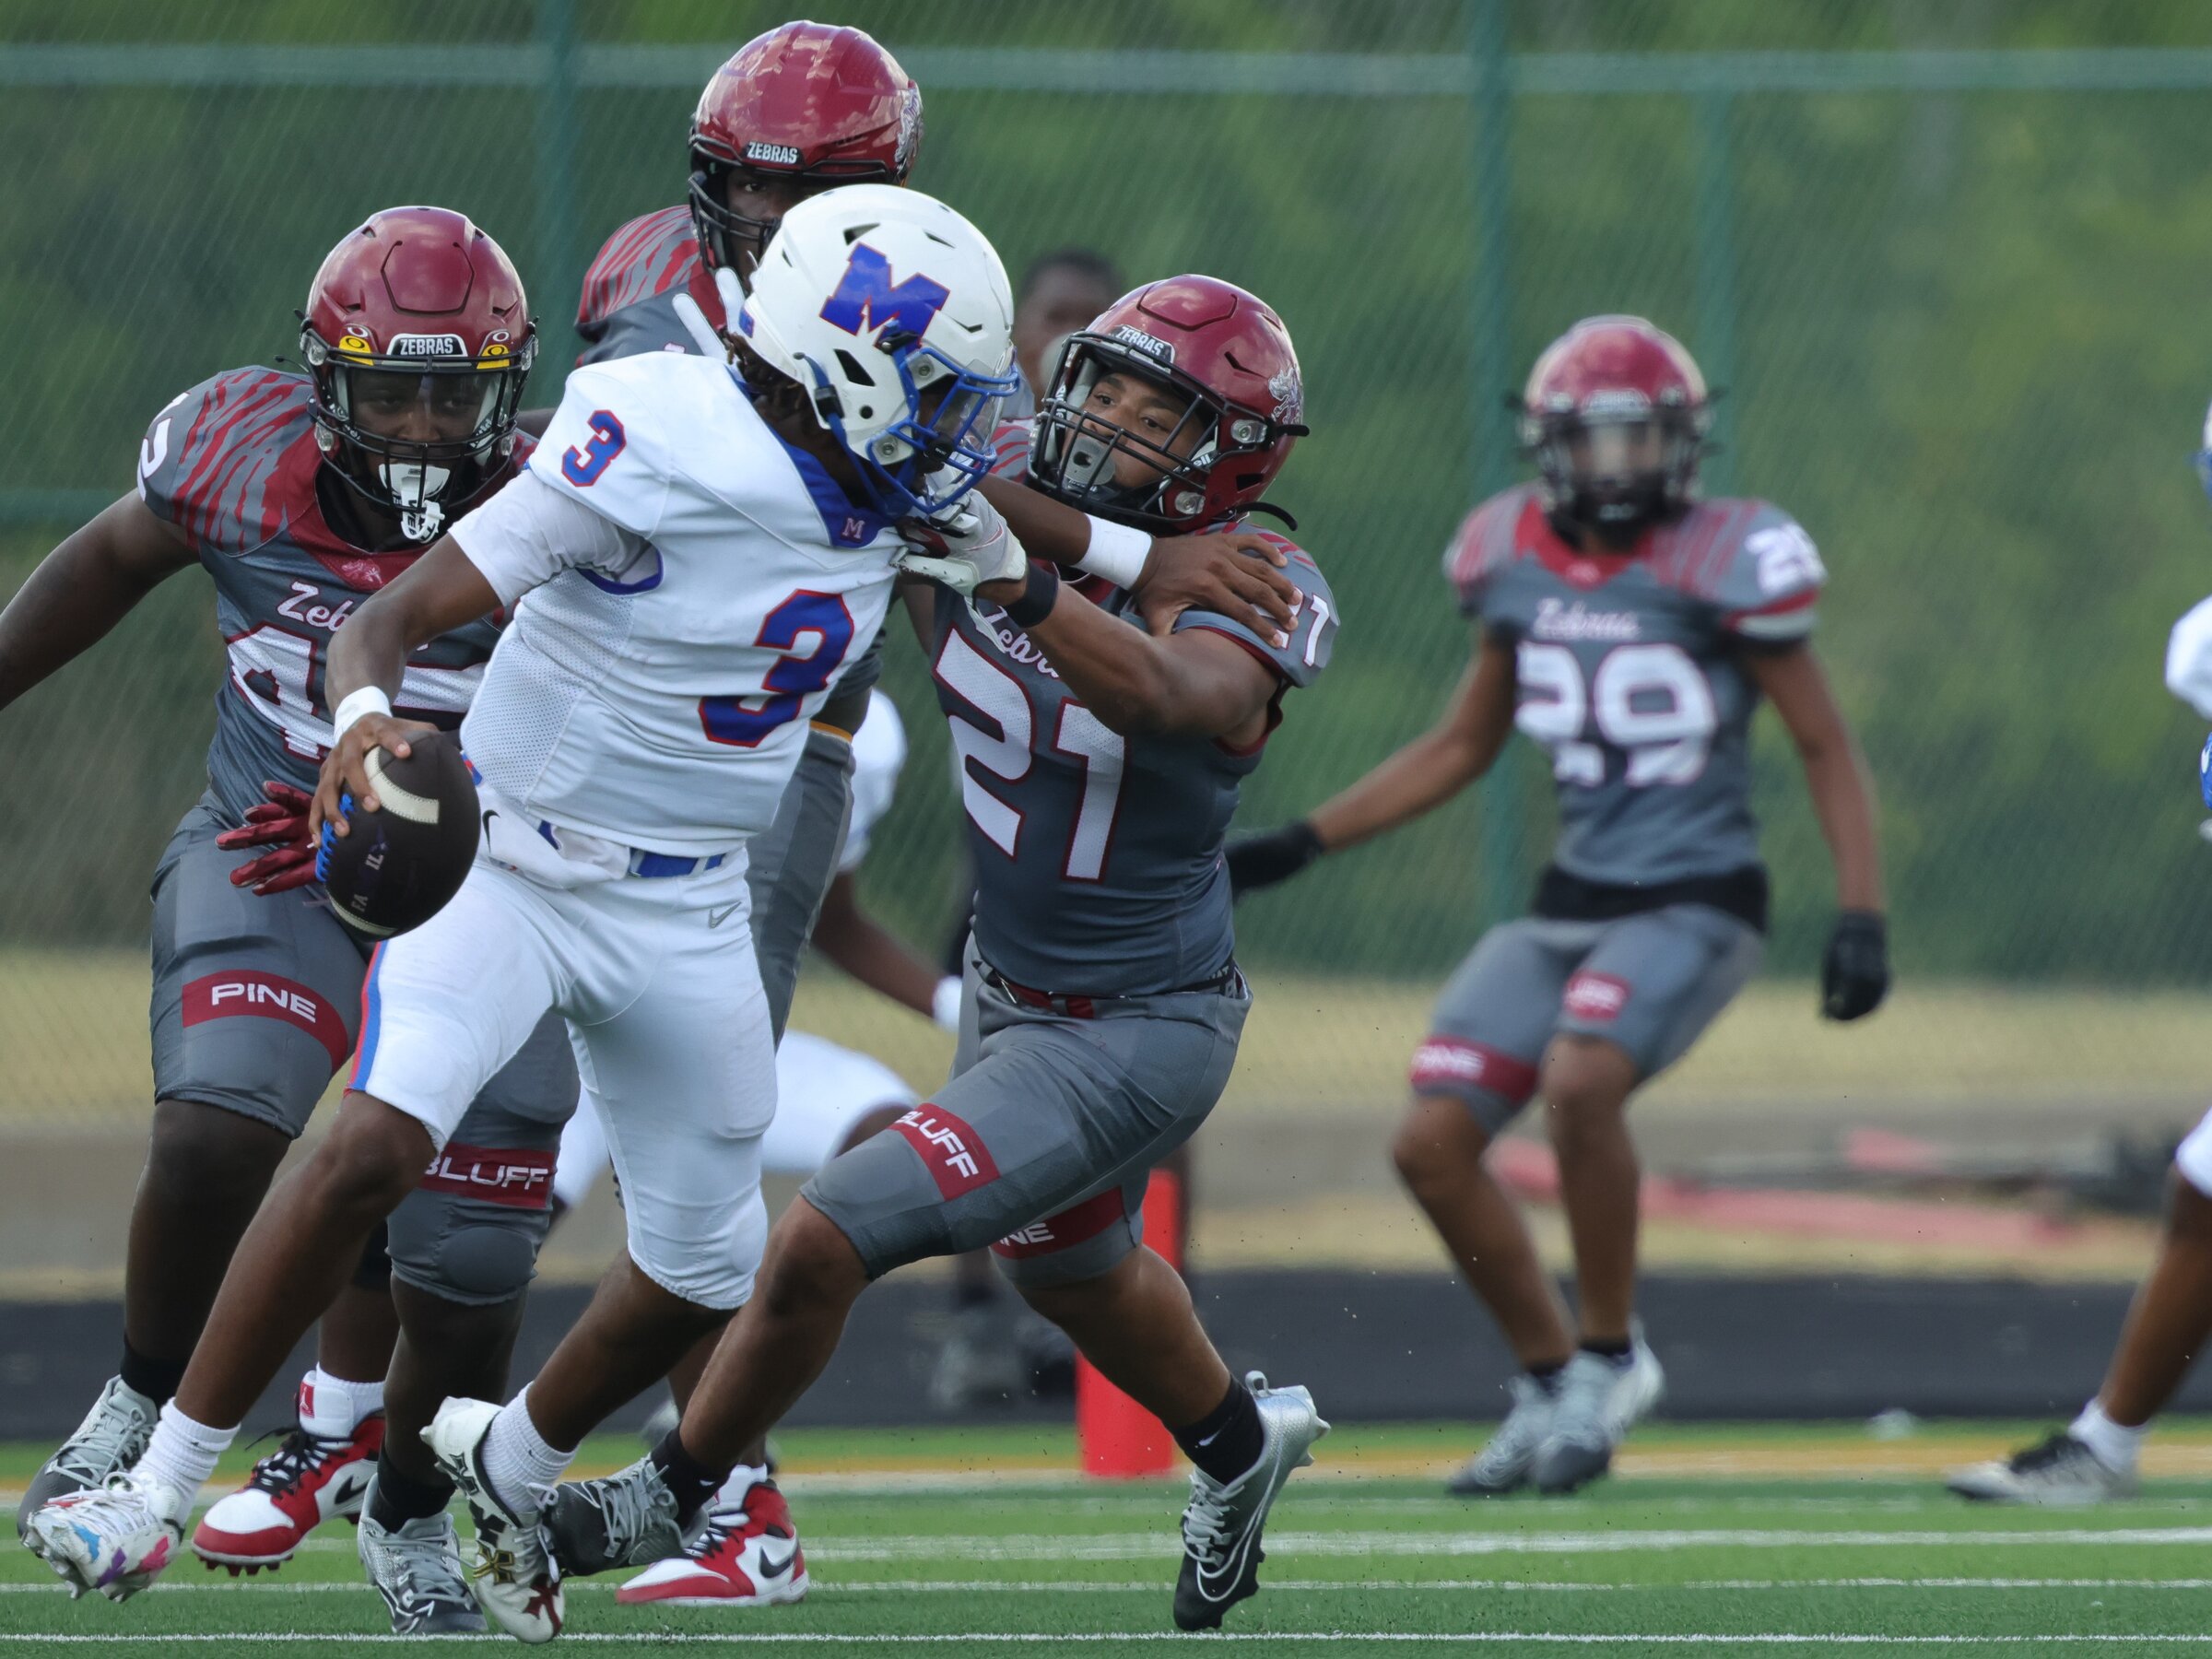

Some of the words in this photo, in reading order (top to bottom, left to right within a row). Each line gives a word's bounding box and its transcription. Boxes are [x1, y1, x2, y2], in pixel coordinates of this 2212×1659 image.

[747, 141, 798, 164] ZEBRAS
[819, 241, 950, 356] M
[399, 337, 453, 356] ZEBRAS
[561, 409, 627, 487] 3
[841, 517, 865, 541] M
[277, 580, 354, 632] Zeb
[699, 588, 854, 747] 3
[1514, 642, 1719, 787] 29
[932, 621, 1129, 885] 21
[211, 982, 317, 1024] PINE
[999, 1222, 1055, 1247] NE
